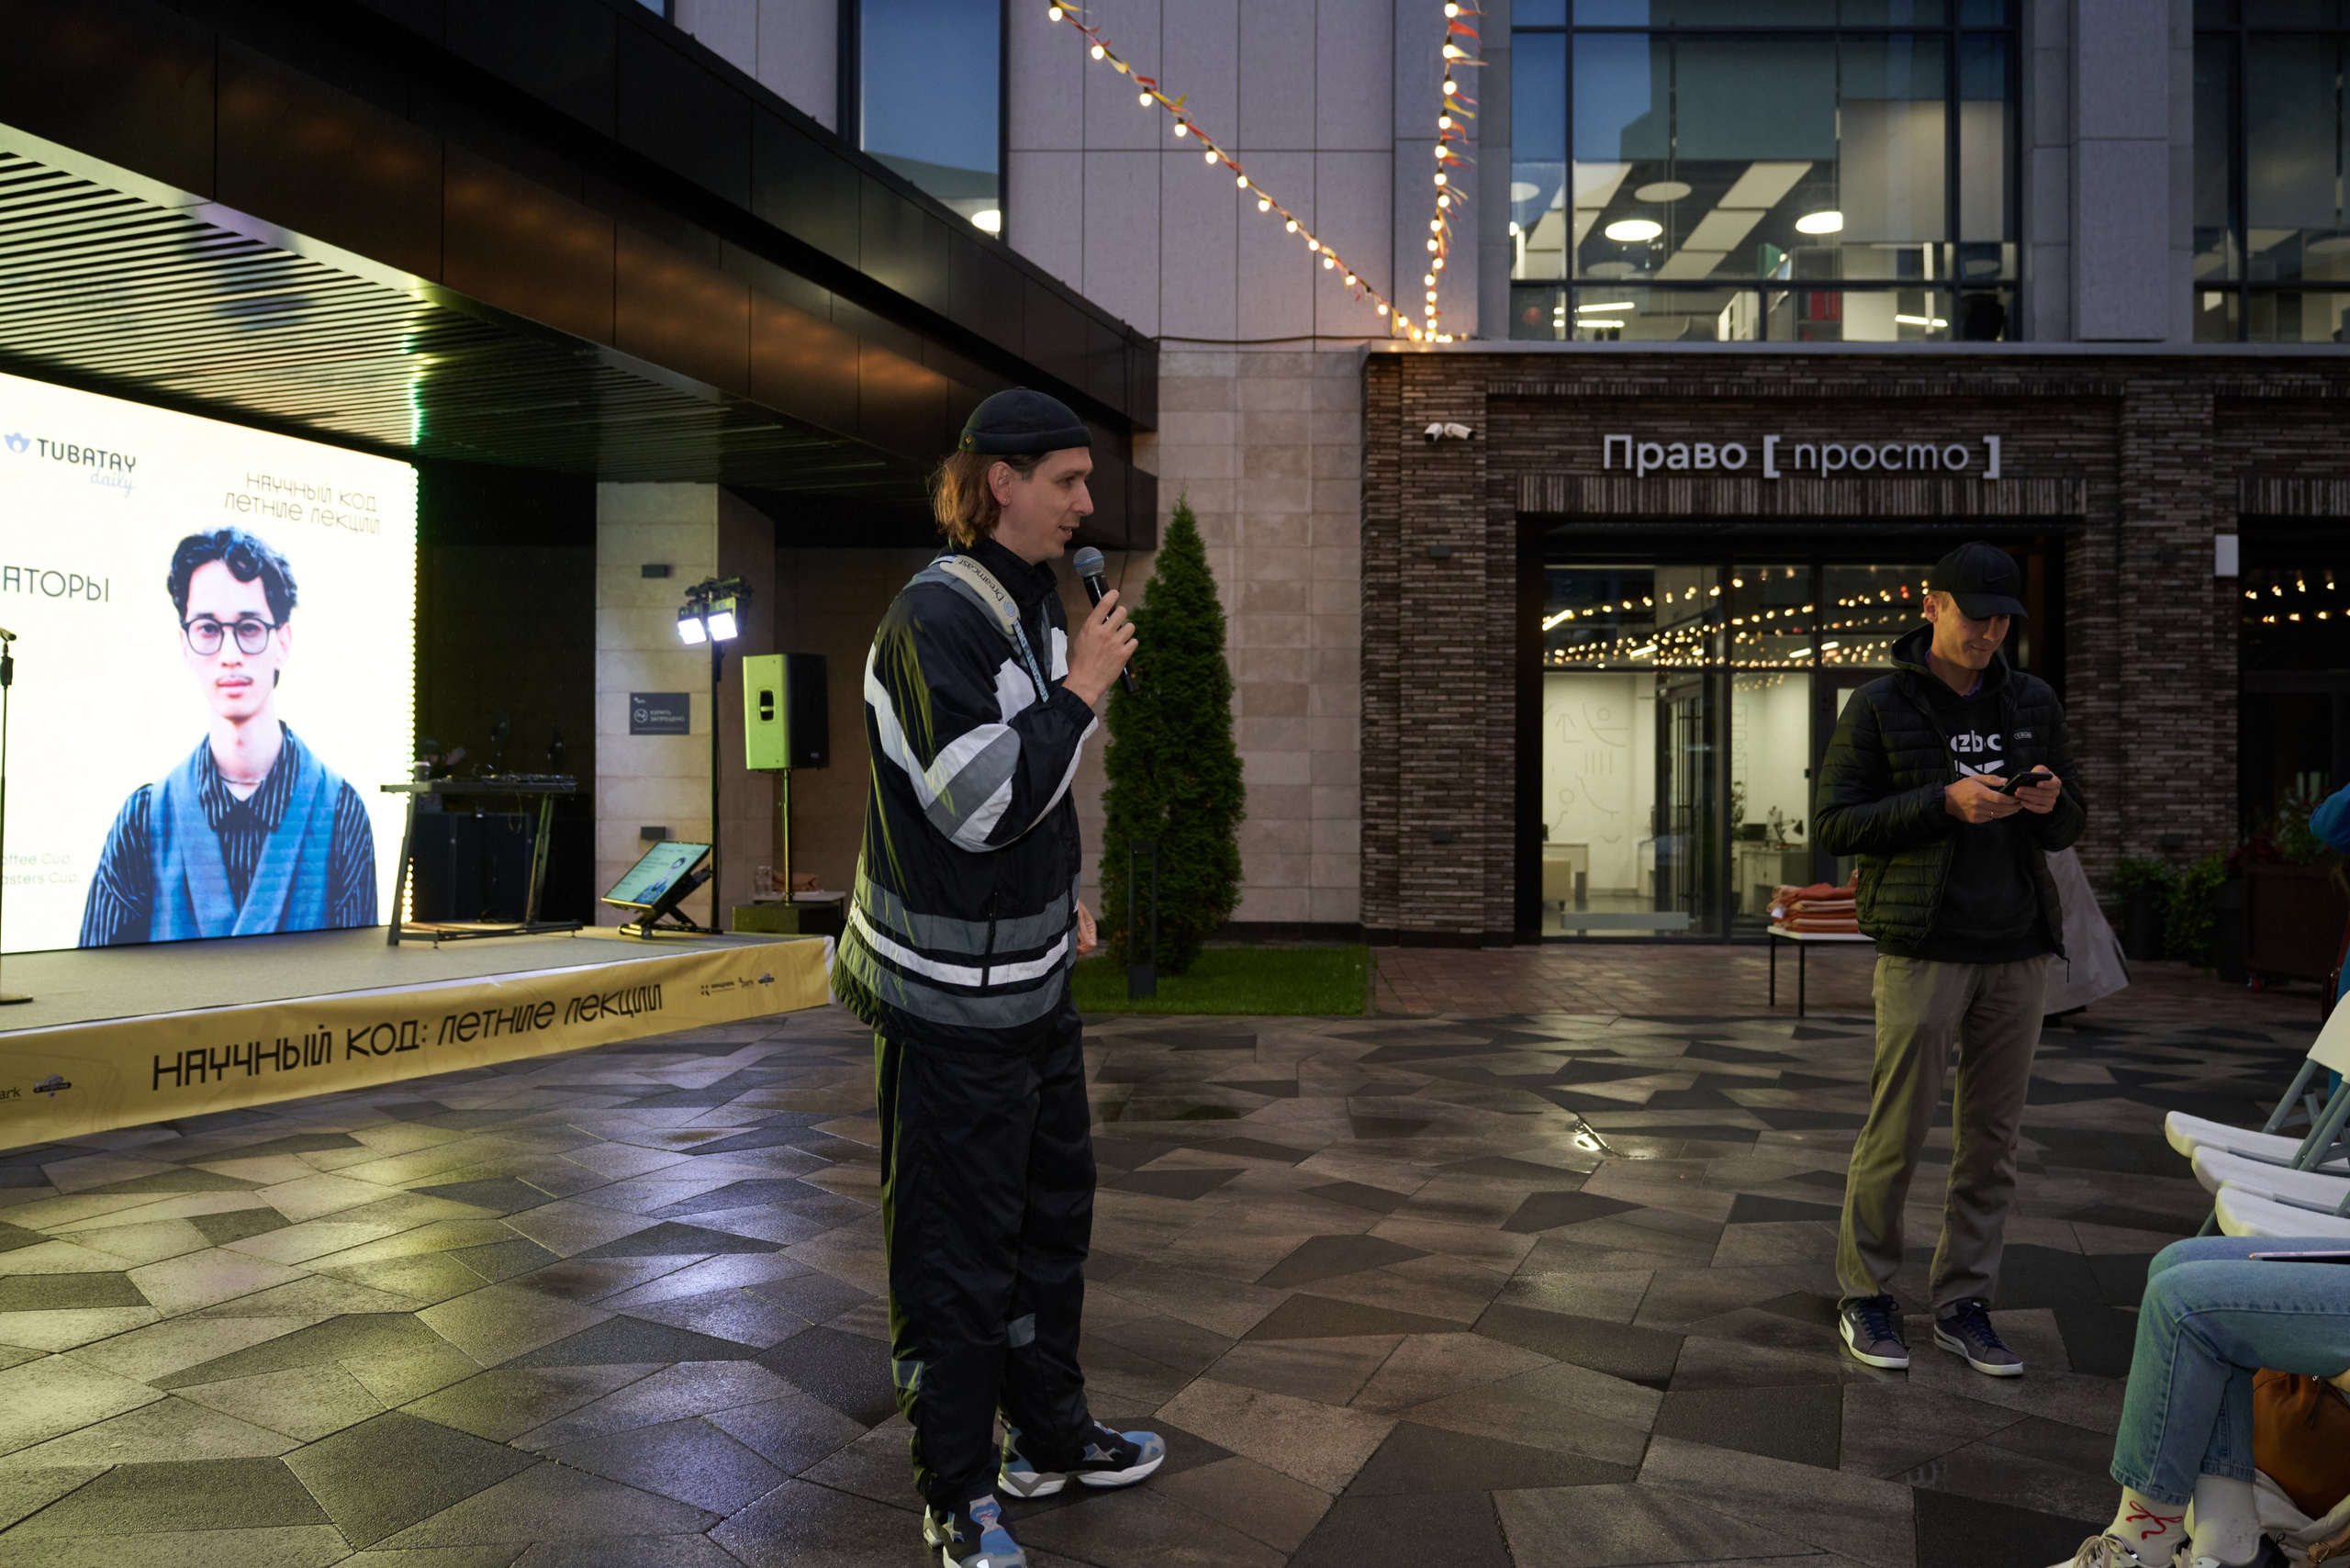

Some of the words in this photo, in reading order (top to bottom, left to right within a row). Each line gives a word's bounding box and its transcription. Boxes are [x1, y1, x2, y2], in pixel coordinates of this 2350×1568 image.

[37, 438, 136, 473] TUBATAY
[1604, 434, 1747, 478] Право
[1795, 443, 1969, 478] просто
[90, 465, 135, 498] daily
[247, 472, 331, 504] НАУЧНЫЙ
[4, 566, 109, 602] АТОРЫ
[958, 558, 1004, 602] Dreamcast
[152, 1025, 331, 1091] НАУЧНЫЙ
[346, 1019, 428, 1059] КОД:
